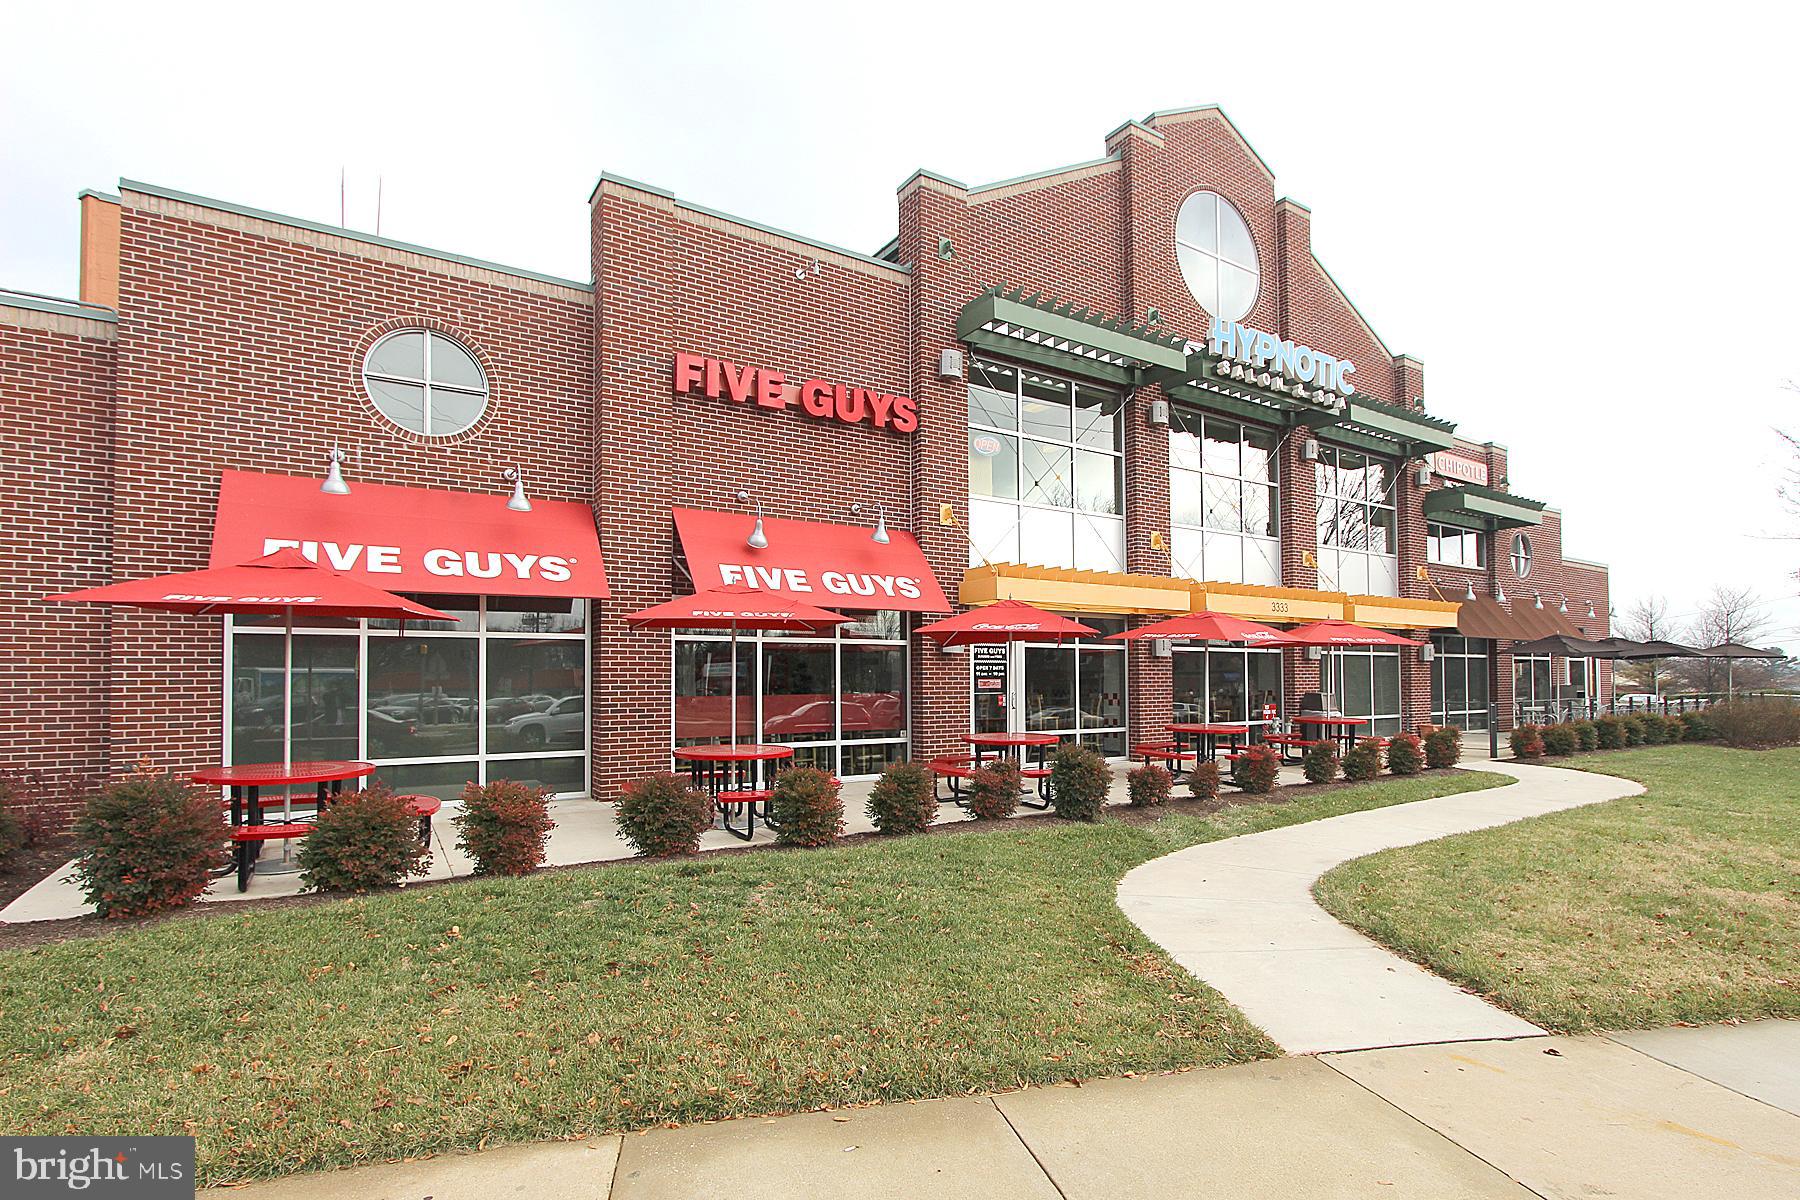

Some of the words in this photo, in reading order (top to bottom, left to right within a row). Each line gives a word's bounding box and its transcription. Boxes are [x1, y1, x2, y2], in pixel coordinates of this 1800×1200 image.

[1208, 316, 1357, 396] HYPNOTIC
[674, 352, 786, 410] FIVE
[801, 379, 918, 433] GUYS
[1217, 360, 1284, 391] SALON
[1312, 389, 1347, 410] SPA
[1437, 456, 1486, 481] CHIPOTLE
[718, 563, 813, 593] FIVE
[161, 594, 232, 602] FIVE
[1271, 602, 1289, 613] 3333
